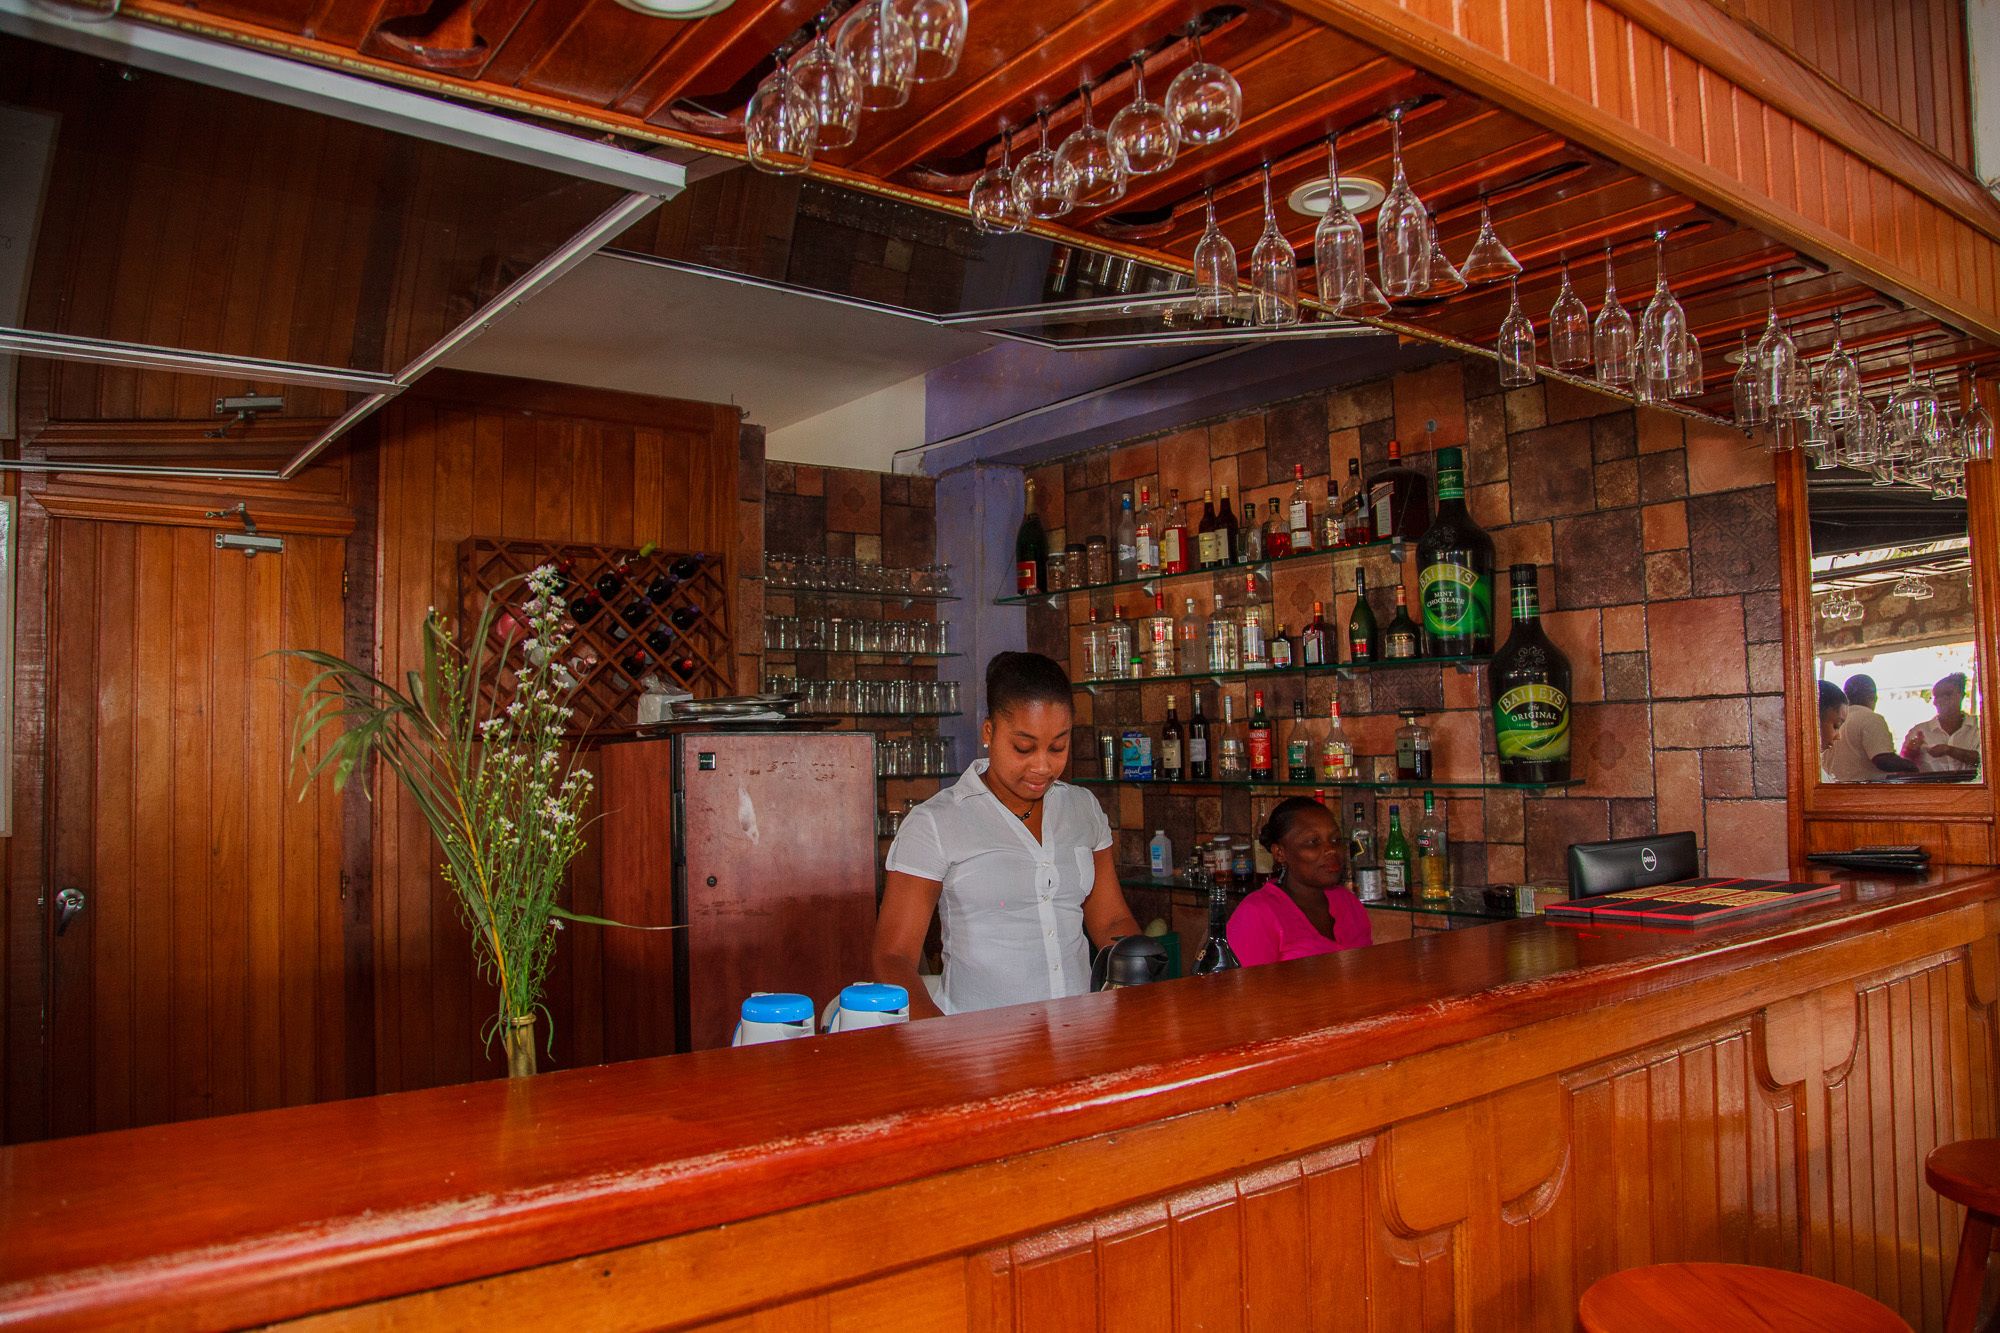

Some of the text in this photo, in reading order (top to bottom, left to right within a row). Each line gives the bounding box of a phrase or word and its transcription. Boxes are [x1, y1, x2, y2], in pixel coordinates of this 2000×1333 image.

[1420, 565, 1473, 589] BAILEYS
[1426, 597, 1465, 608] CHOCOLATE
[1502, 687, 1563, 709] BAILEYS
[1511, 711, 1557, 722] ORIGINAL
